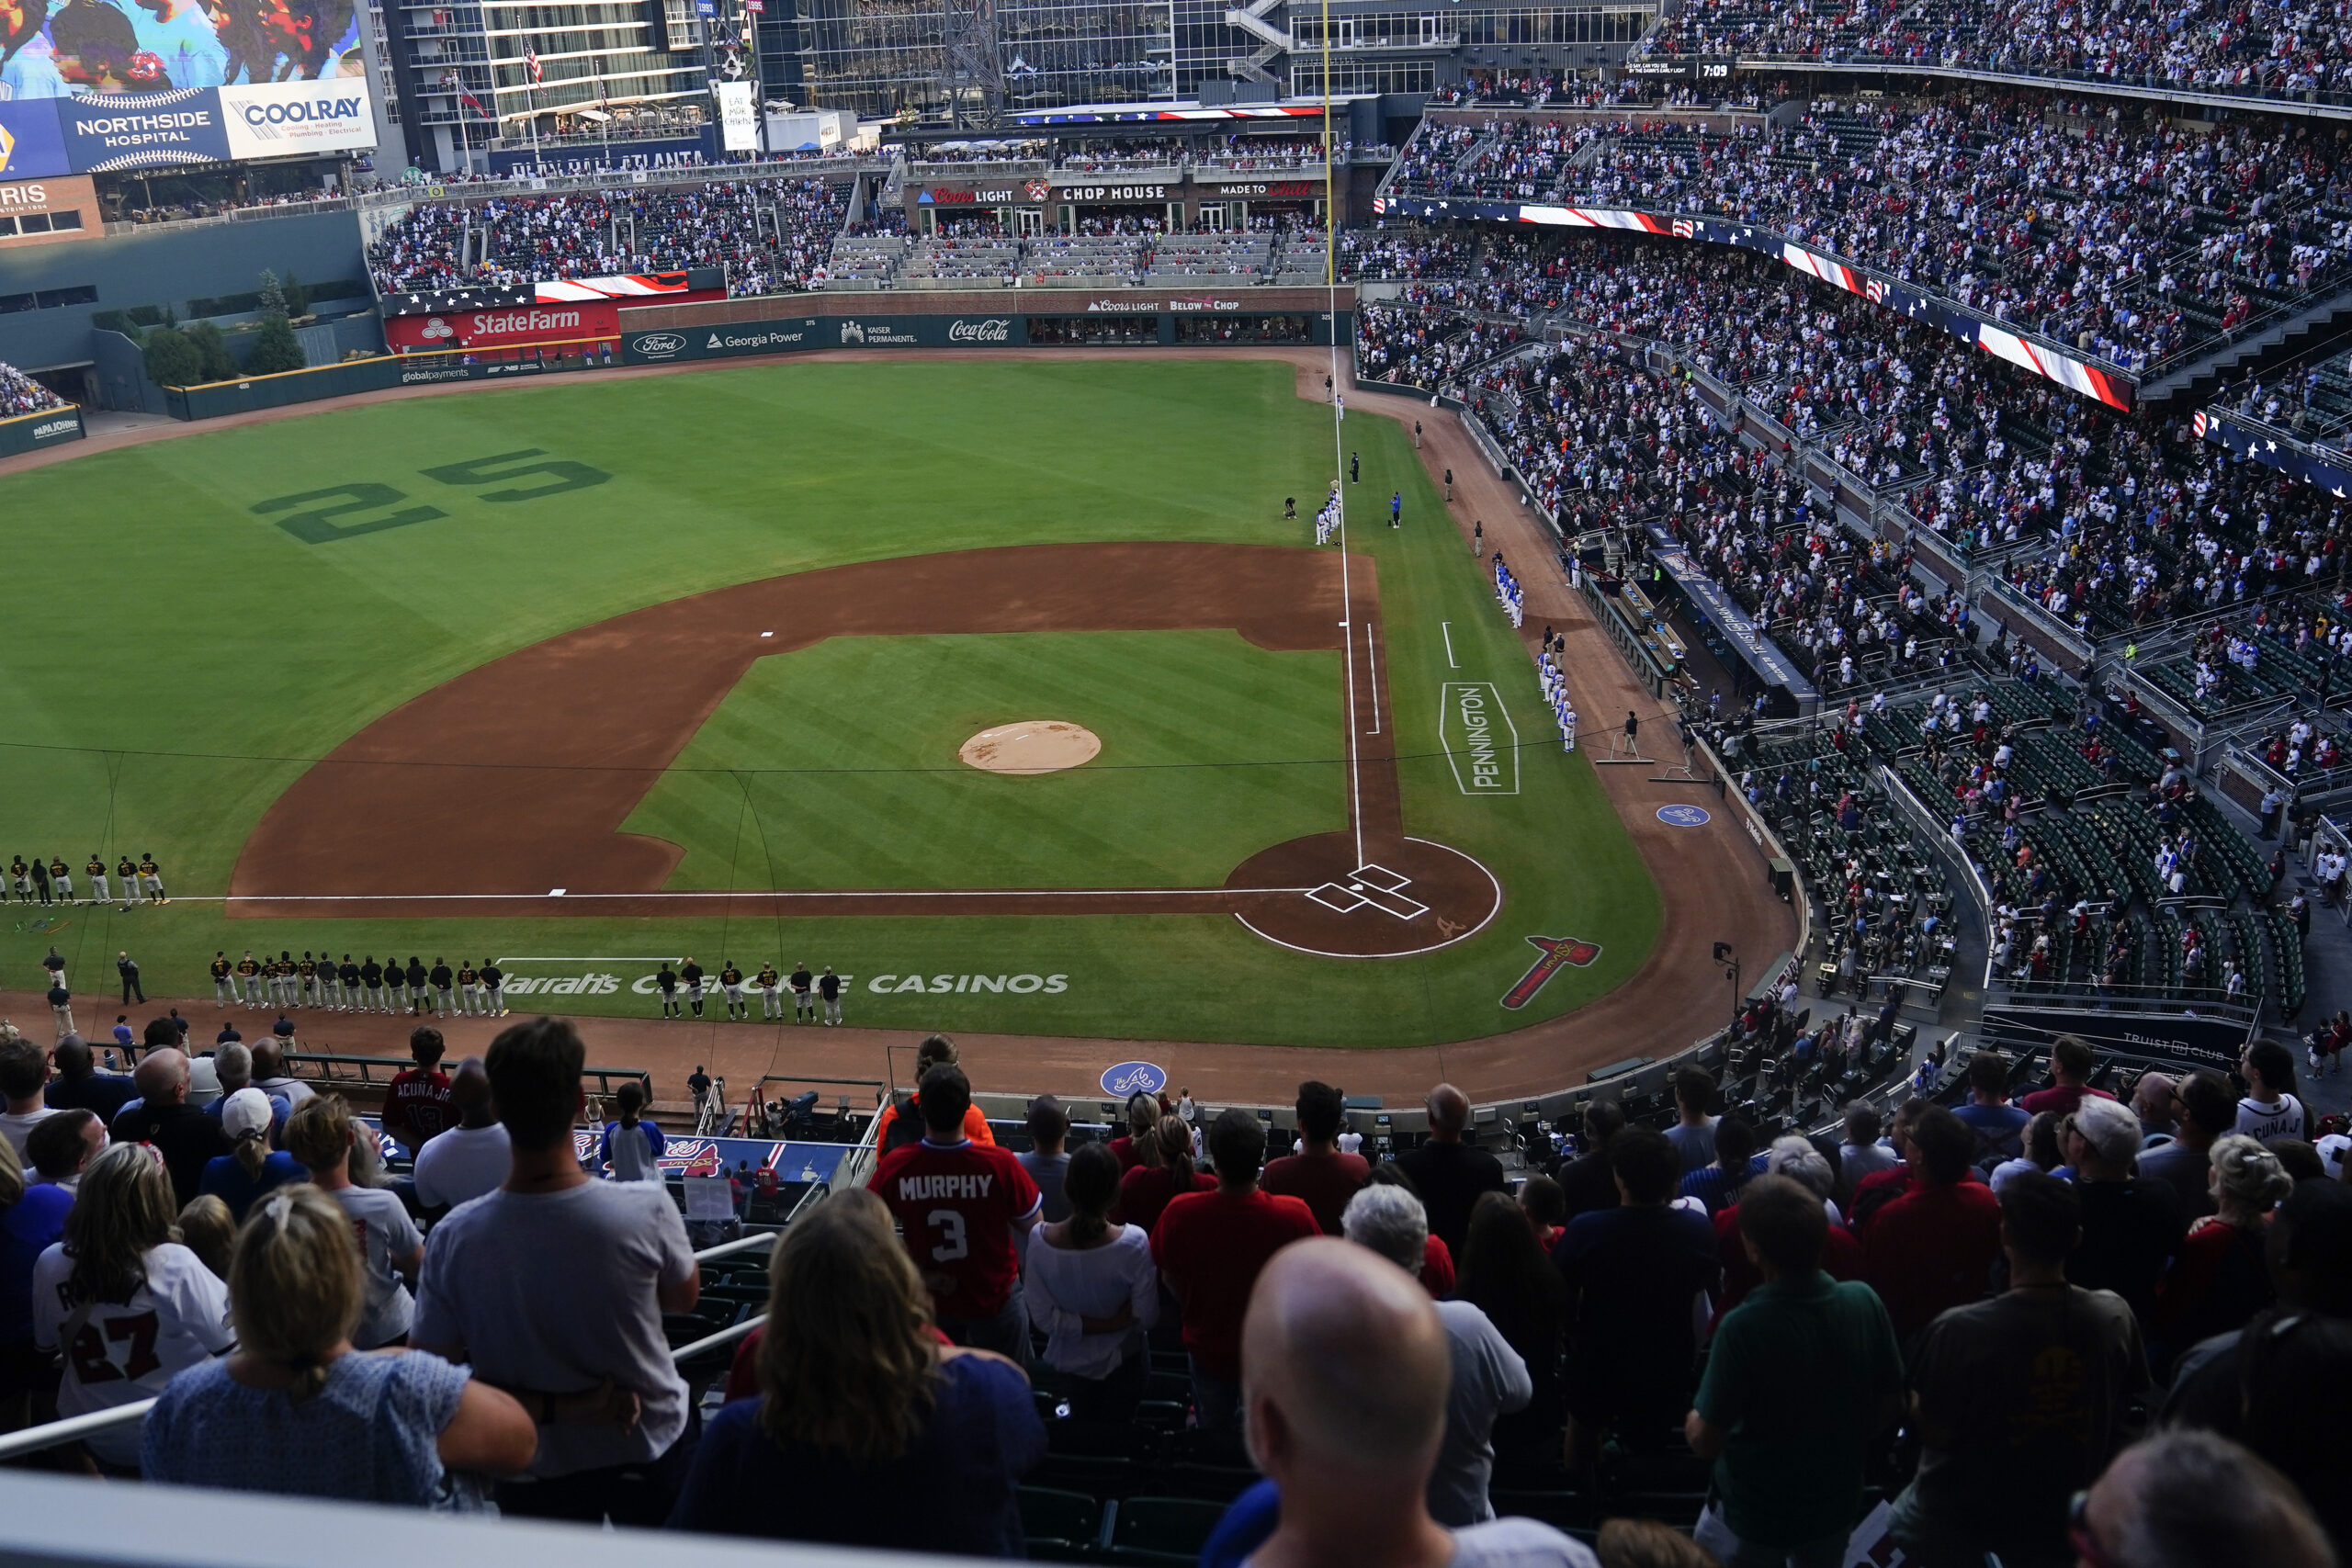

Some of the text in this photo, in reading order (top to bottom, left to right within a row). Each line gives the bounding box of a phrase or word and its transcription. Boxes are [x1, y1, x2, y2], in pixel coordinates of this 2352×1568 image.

[697, 3, 714, 13] 1993
[747, 0, 763, 11] 1995
[1703, 65, 1727, 77] 7:09
[729, 97, 743, 106] EAT
[244, 96, 362, 126] COOLRAY
[75, 110, 211, 136] NORTHSIDE
[281, 120, 343, 133] Cooling Heating
[105, 130, 190, 148] HOSPITAL
[289, 126, 362, 139] Plumbing Electrical
[933, 186, 1012, 203] Coors LIGHT
[1063, 187, 1105, 200] CHOP
[1112, 186, 1165, 199] HOUSE
[1220, 181, 1312, 197] MADE TO Chill
[1100, 299, 1159, 311] Coors LIGHT
[867, 326, 890, 334] KAISER
[642, 335, 677, 352] Ford
[725, 331, 803, 348] Georgia Power
[248, 447, 615, 546] 25
[1716, 605, 1742, 624] PARK
[1457, 687, 1502, 788] PENNINGTON
[867, 974, 1069, 994] CASINOS
[2123, 1032, 2225, 1061] TRUIST CLUB
[397, 1080, 434, 1100] ACUÑA
[2244, 1117, 2291, 1142] CUÑA
[899, 1174, 992, 1201] MURPHY
[927, 1209, 968, 1263] 3
[59, 1309, 163, 1384] 27
